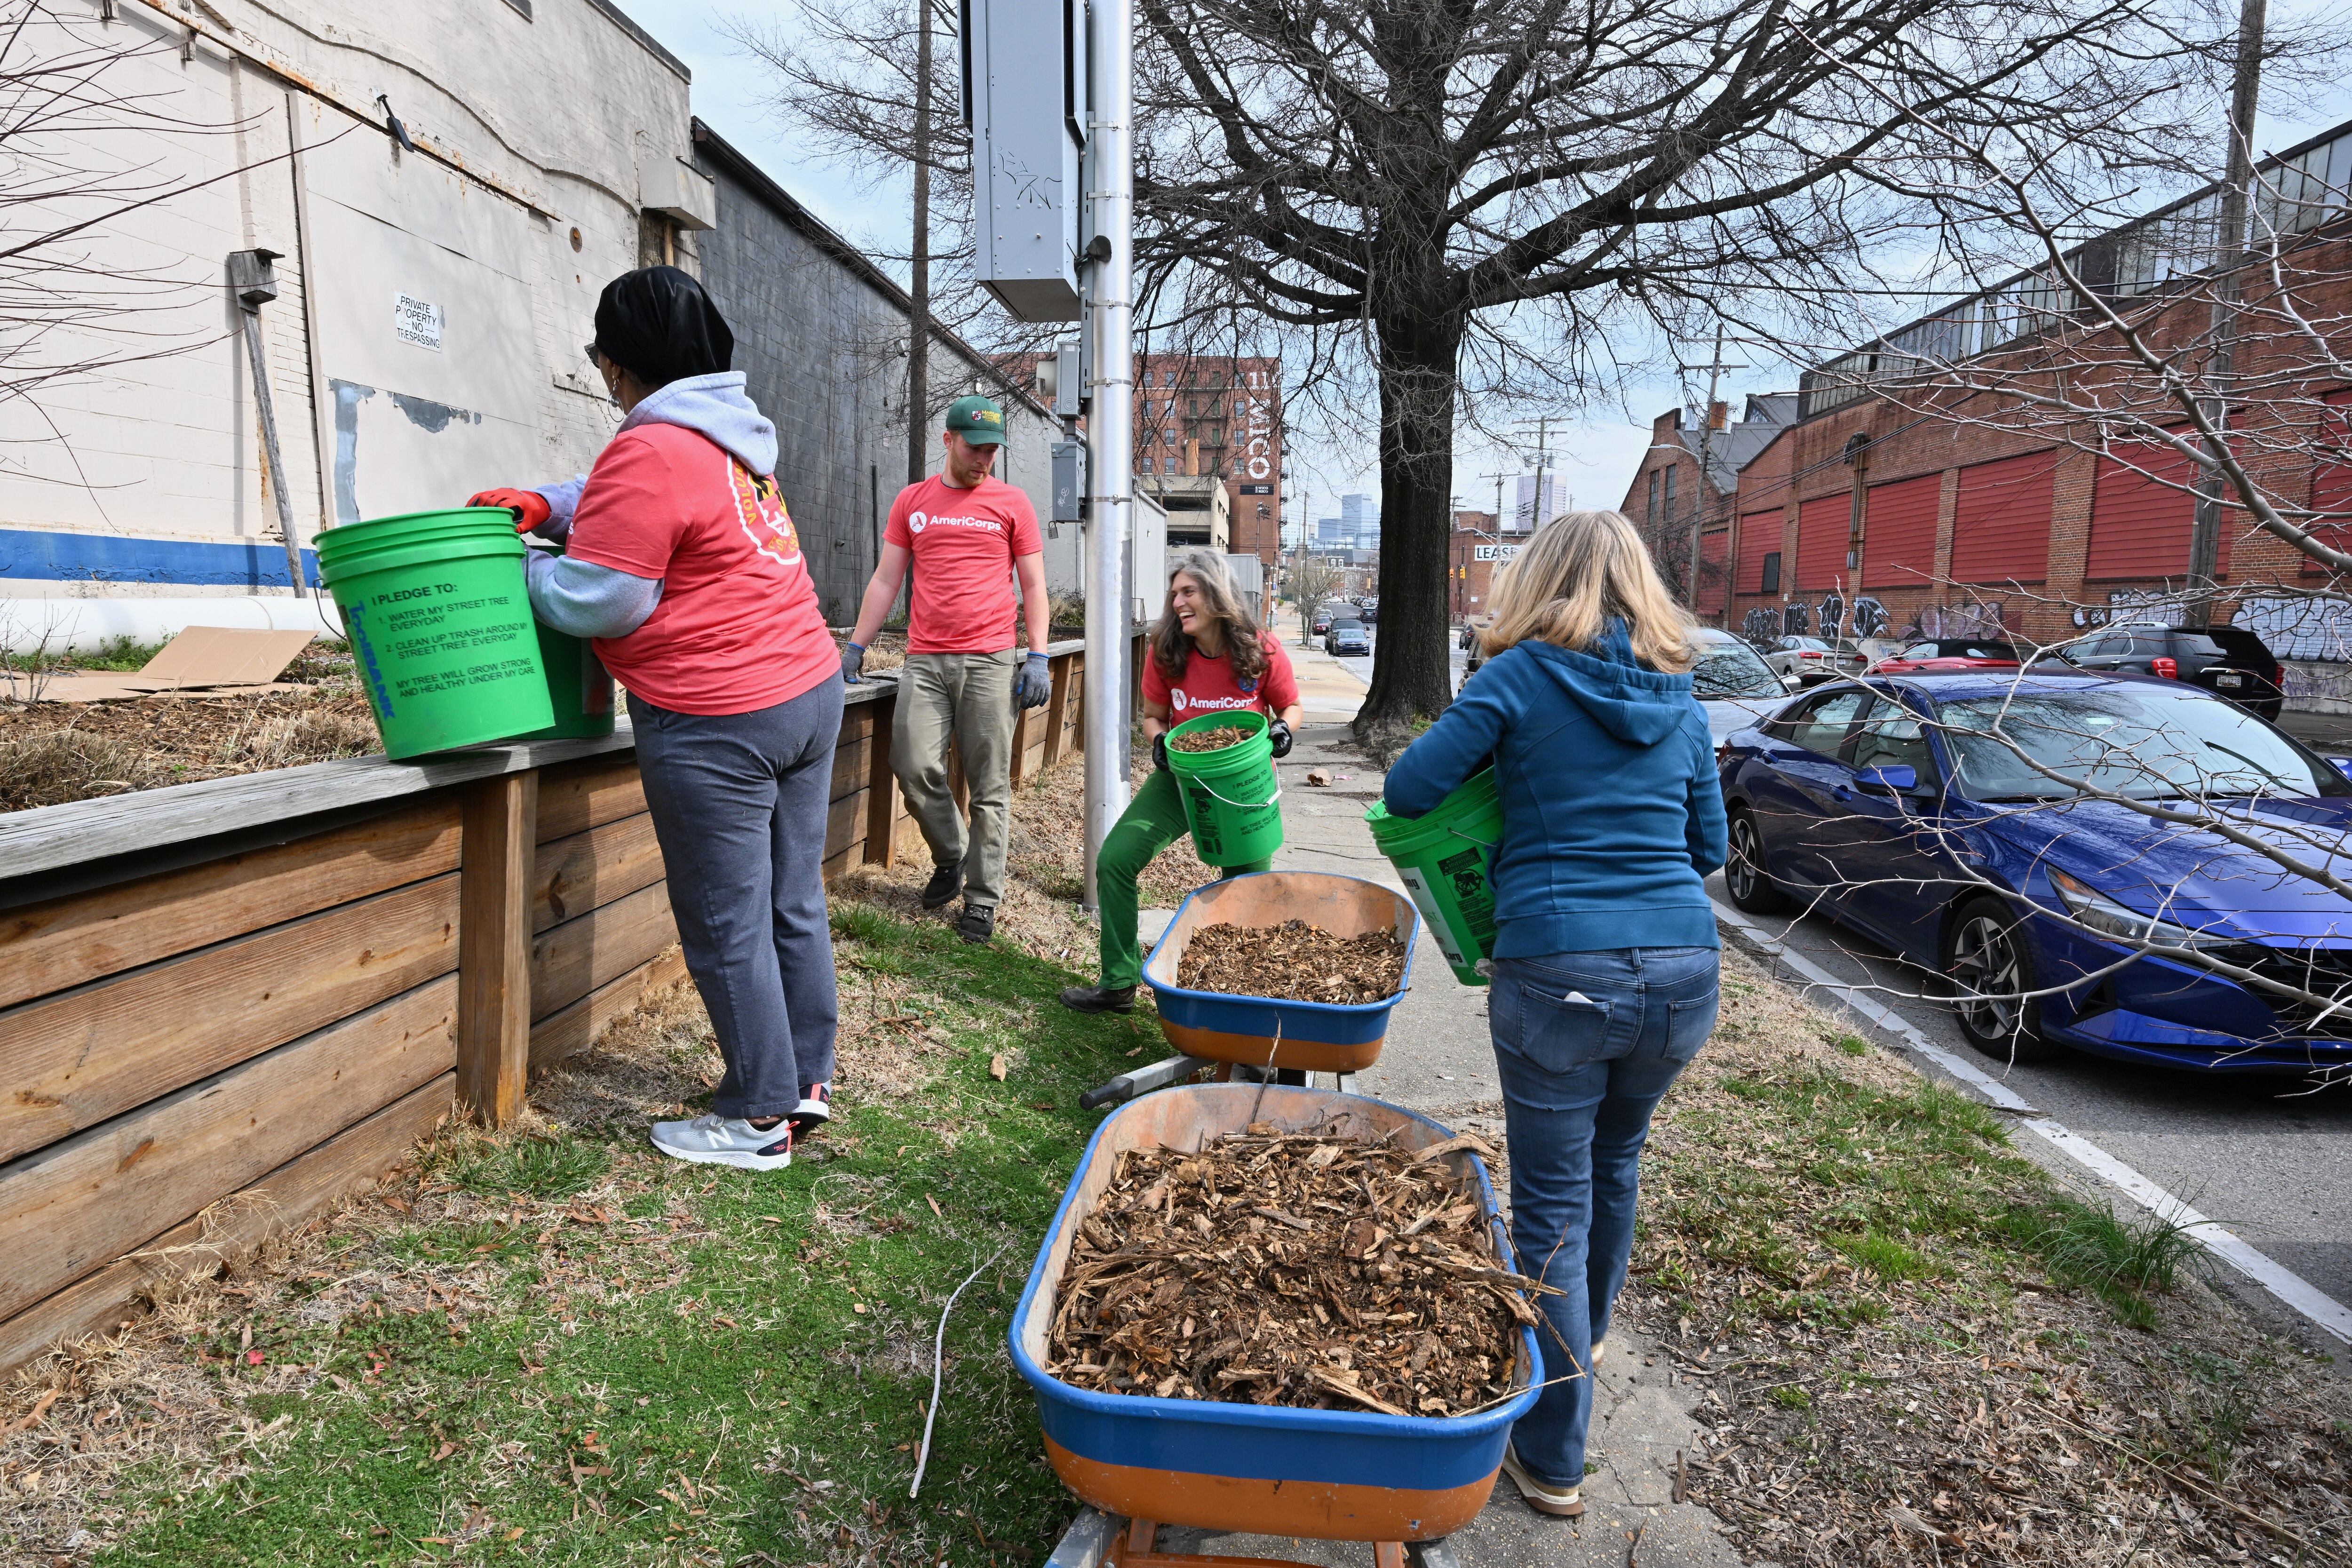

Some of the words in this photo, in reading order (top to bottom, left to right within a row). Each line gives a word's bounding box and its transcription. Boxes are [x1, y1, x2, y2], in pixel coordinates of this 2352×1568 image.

[396, 305, 437, 326] POPERTY
[401, 296, 430, 314] PRIVATE
[412, 320, 423, 333] NO
[397, 327, 440, 348] TRESPASSING
[735, 462, 757, 525] VOLUN
[930, 515, 1001, 531] AmeriCorps
[372, 597, 376, 605] I
[378, 587, 432, 605] PLEDGE
[434, 583, 458, 594] TO:
[388, 609, 425, 622] WATER
[427, 605, 444, 615] MY
[447, 599, 486, 612] STREET
[487, 597, 509, 606] TREE
[390, 615, 445, 632] EVERYDAY
[396, 637, 429, 650] CLEAN
[431, 634, 446, 643] UP
[448, 628, 484, 640] TRASH
[486, 623, 518, 635] AROUND
[398, 645, 437, 659] STREET
[439, 640, 469, 651] TREE
[472, 632, 517, 646] EVERYDAY
[396, 679, 409, 689] MY
[412, 674, 439, 685] TREE
[440, 669, 465, 680] WILL
[467, 663, 499, 675] GROW
[501, 658, 531, 669] STRONG
[400, 688, 419, 698] AND
[421, 678, 466, 693] HEALTHY
[469, 672, 504, 685] UNDER
[505, 669, 517, 678] MY
[518, 666, 535, 676] CARE
[1236, 774, 1260, 788] PLEDGE
[1240, 787, 1258, 796] WATER
